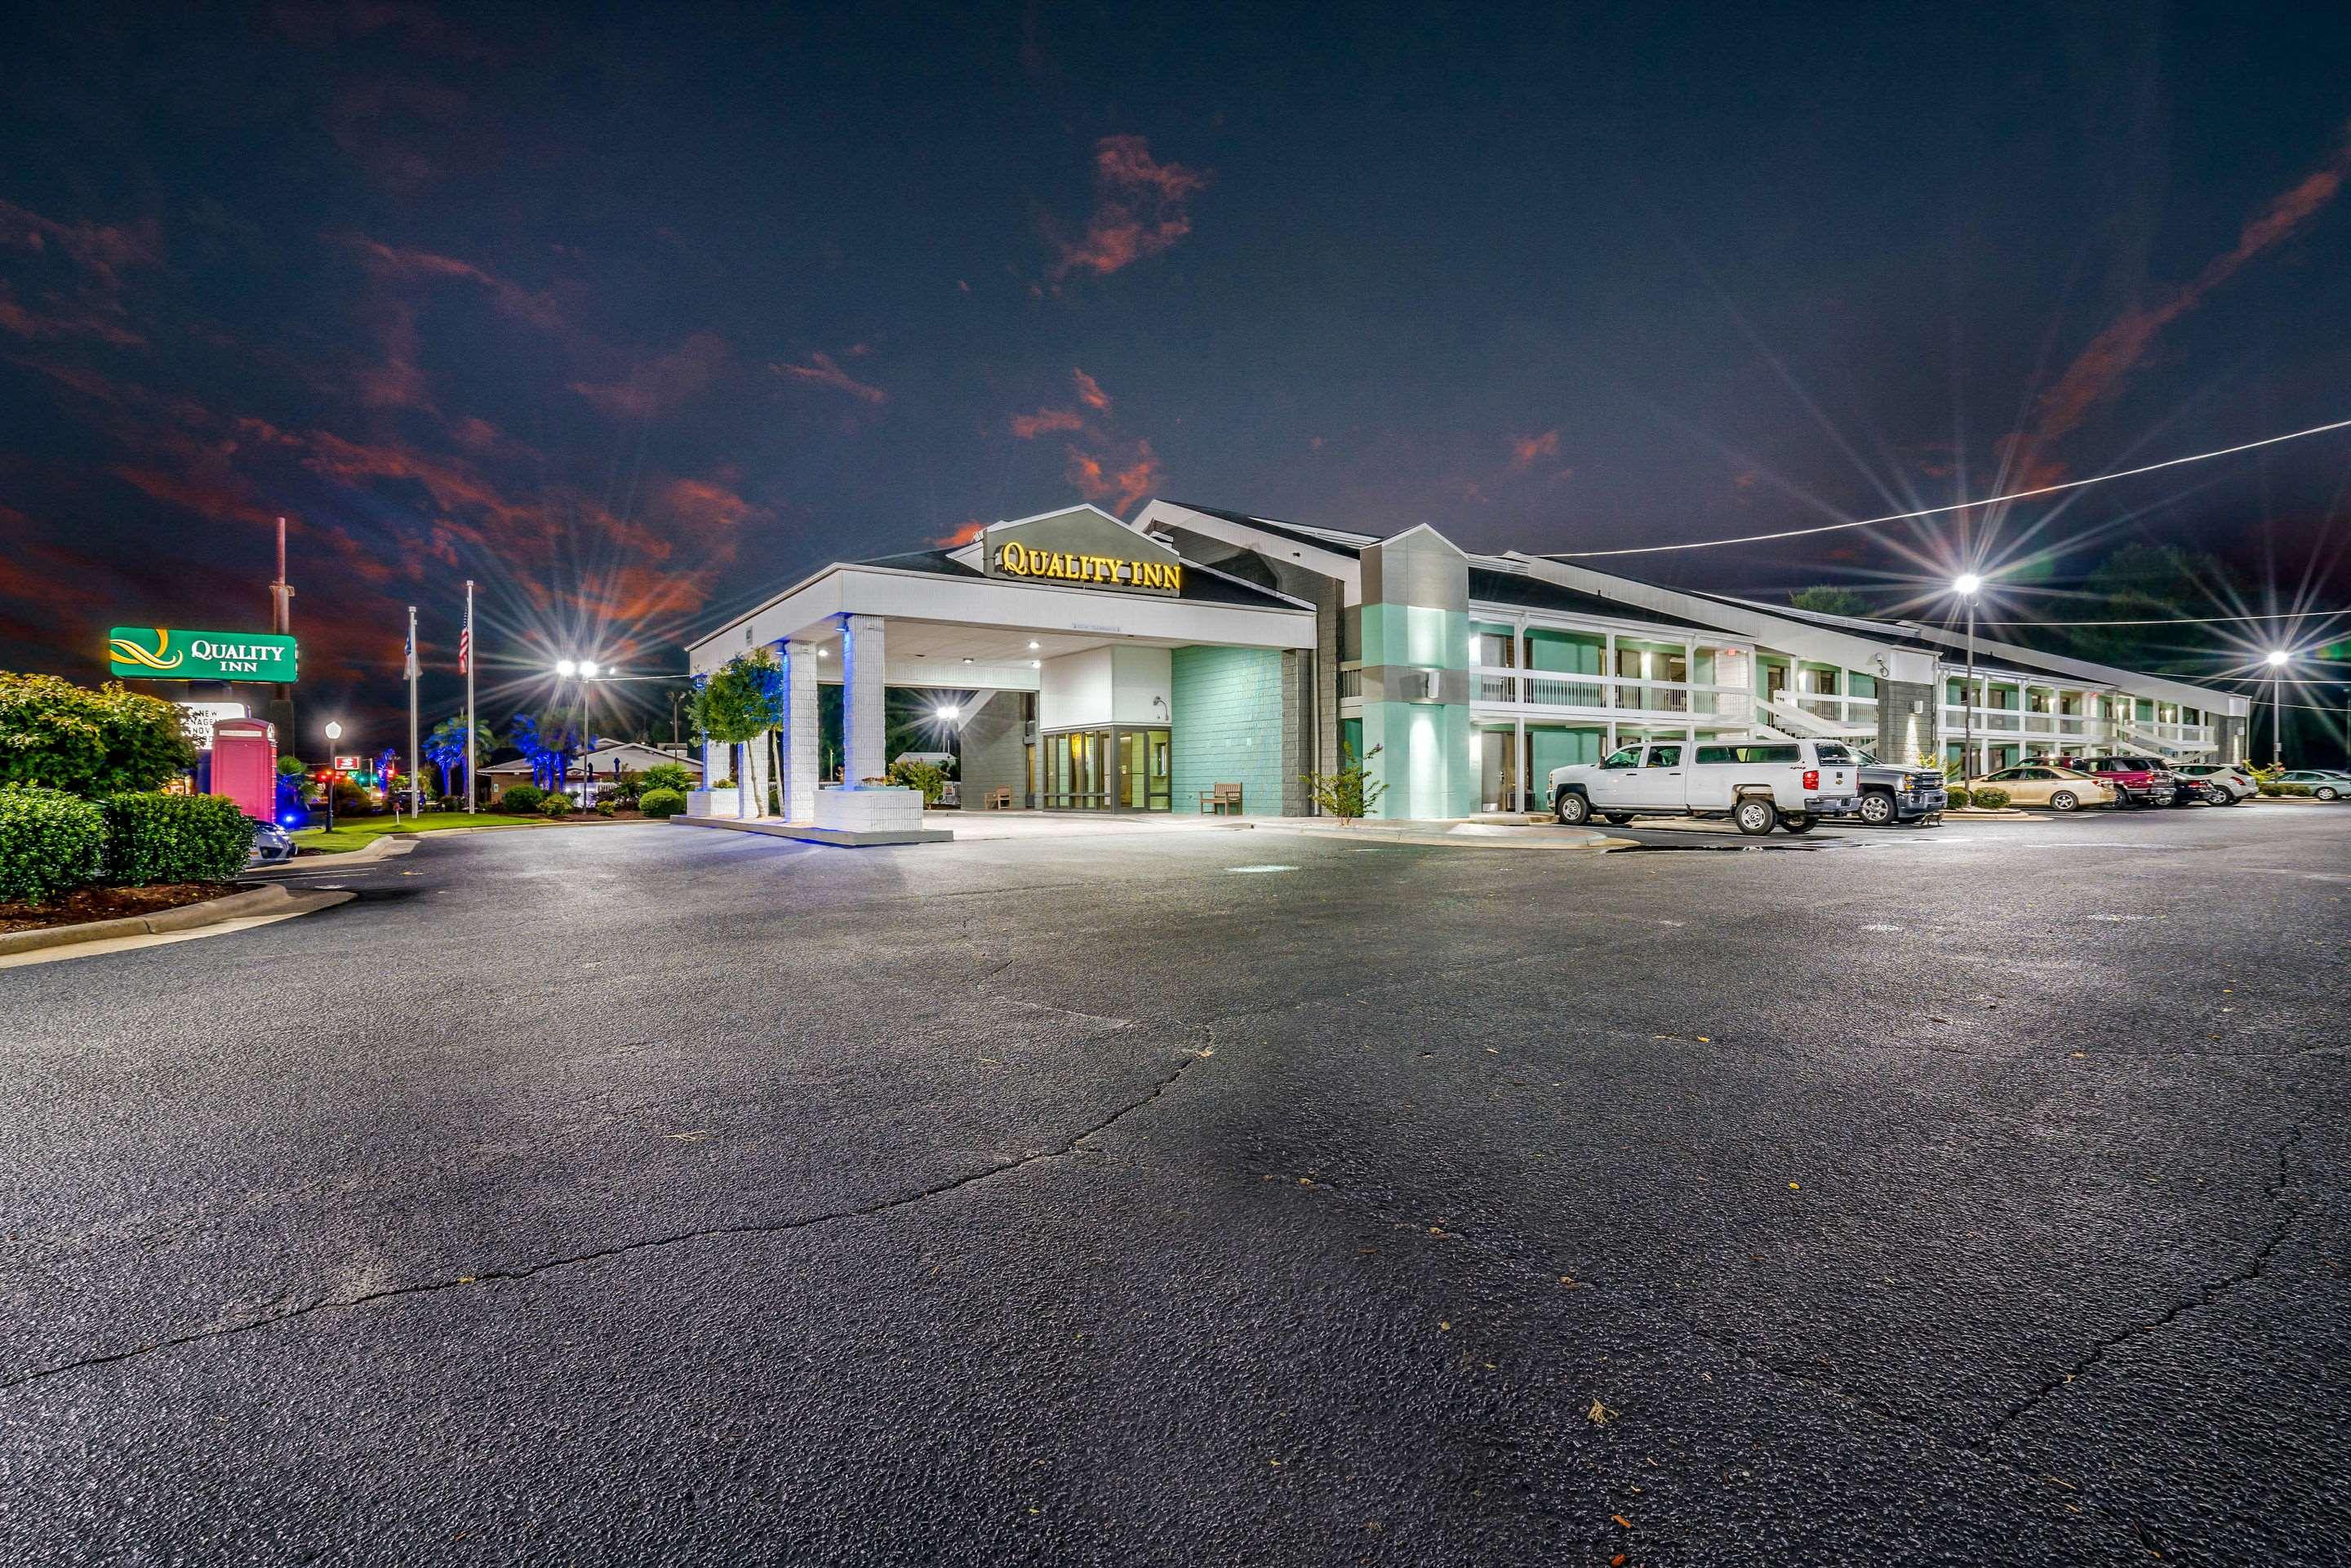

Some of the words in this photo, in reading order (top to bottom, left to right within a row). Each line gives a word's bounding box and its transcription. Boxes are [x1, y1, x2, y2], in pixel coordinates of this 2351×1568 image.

[1002, 541, 1124, 583] QUALITY
[1131, 561, 1180, 589] INN
[191, 640, 285, 662] QUALITY
[220, 661, 258, 673] INN
